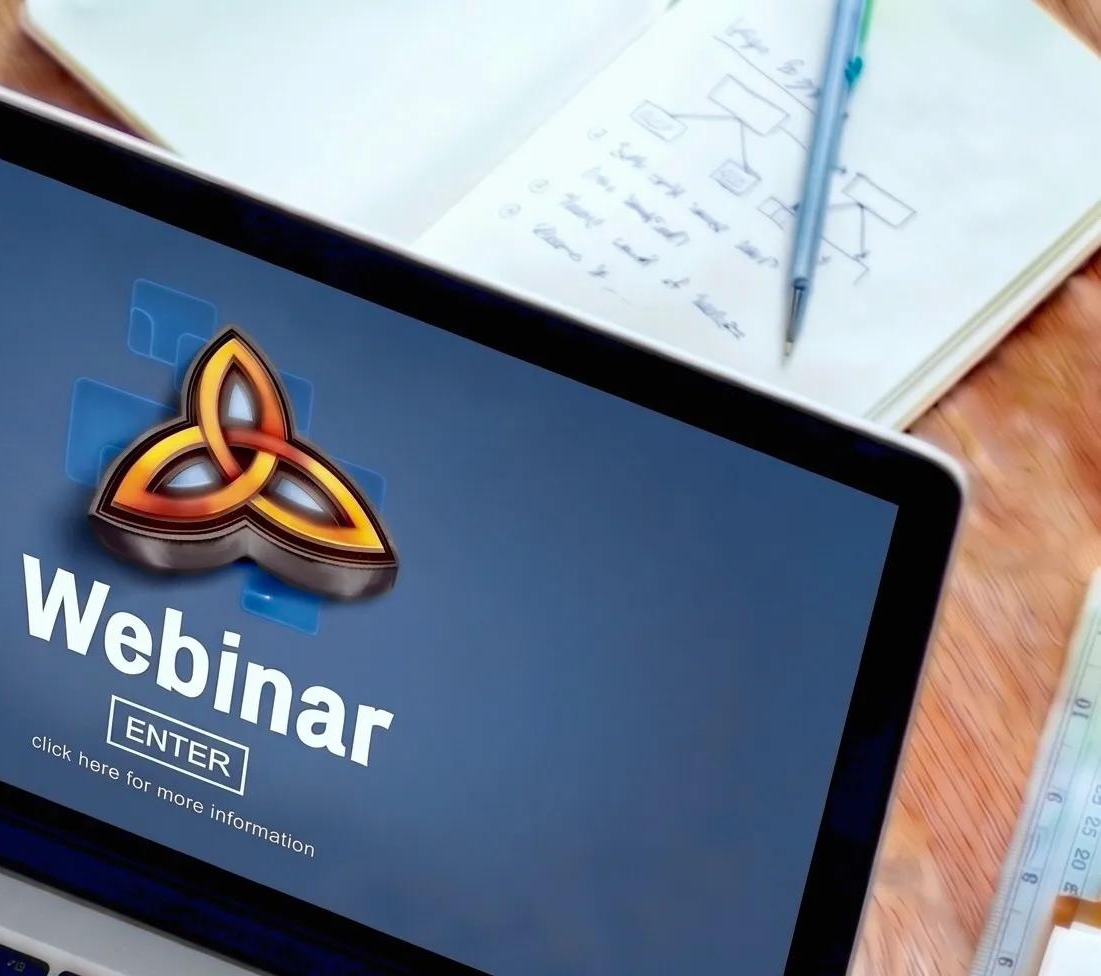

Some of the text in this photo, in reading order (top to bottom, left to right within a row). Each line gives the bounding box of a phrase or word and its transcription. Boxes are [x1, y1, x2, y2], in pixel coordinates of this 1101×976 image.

[23, 554, 395, 767] Webinar
[32, 734, 316, 858] click here for more information
[126, 716, 231, 778] ENTER
